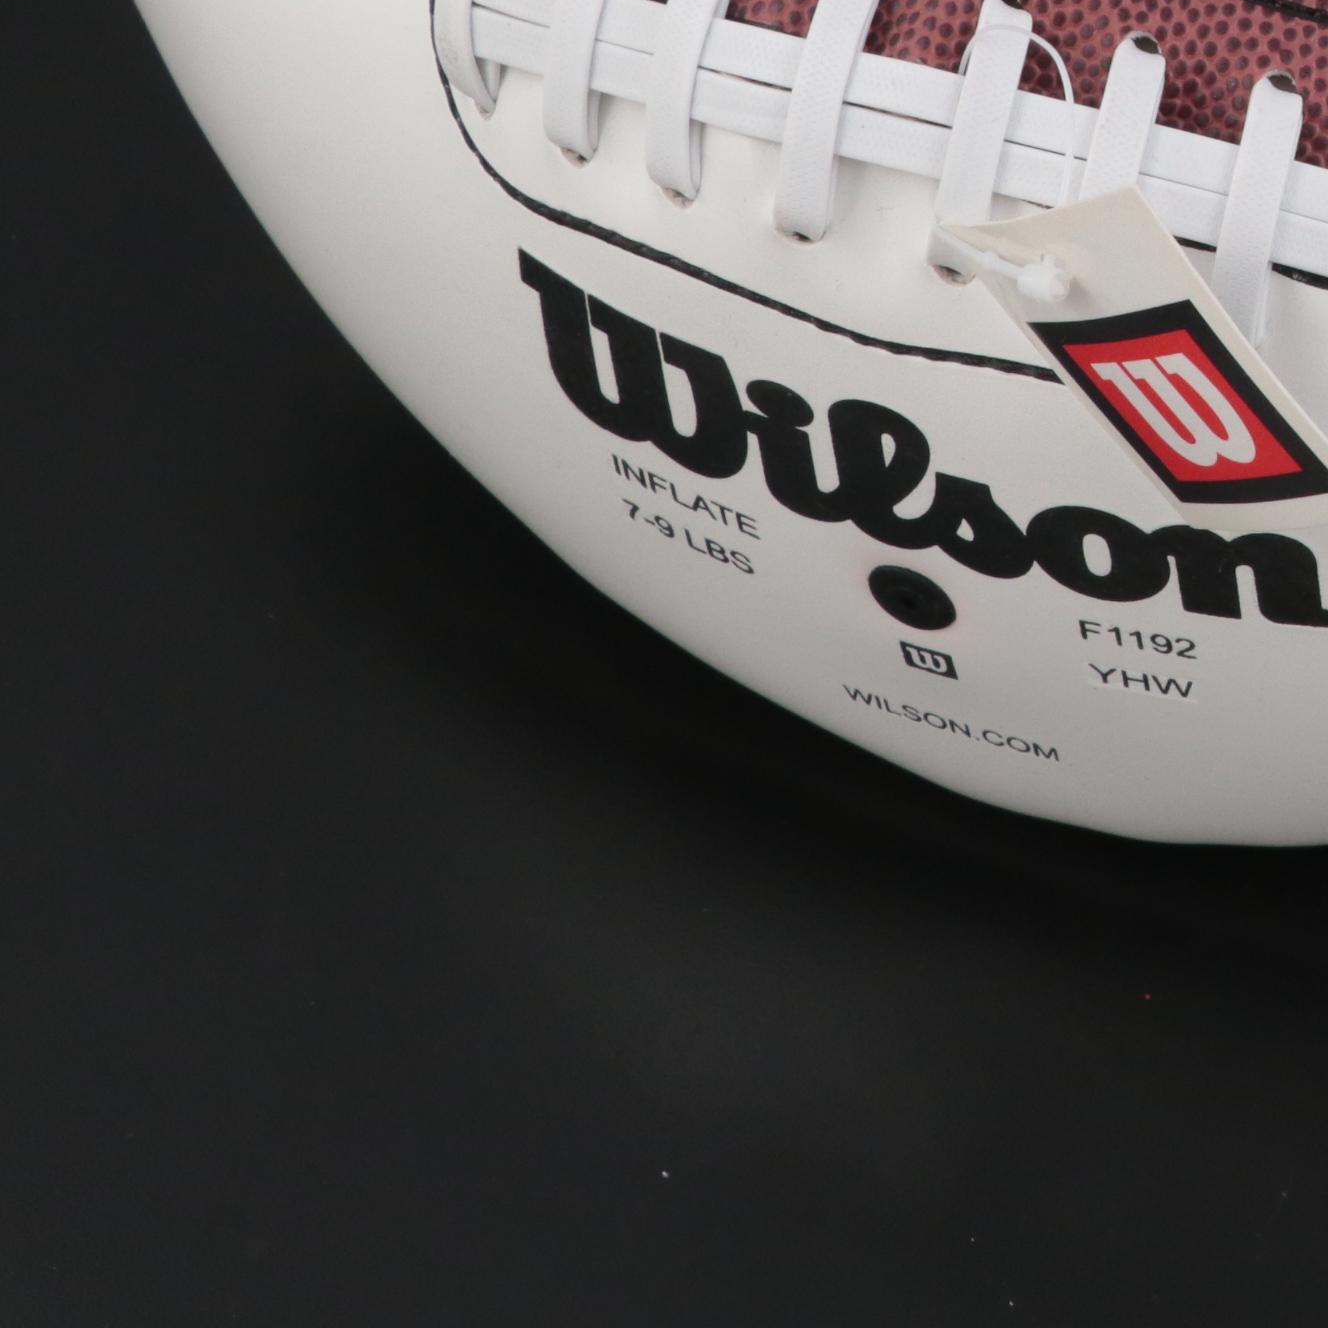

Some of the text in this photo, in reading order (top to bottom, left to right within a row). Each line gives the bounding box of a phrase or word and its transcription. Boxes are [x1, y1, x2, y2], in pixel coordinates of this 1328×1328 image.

[611, 453, 761, 541] INFLATE
[621, 497, 755, 575] 7-9 LBS
[1078, 618, 1198, 660] F1192
[1088, 662, 1194, 699] YHW
[842, 683, 1061, 762] WILSON.COM
